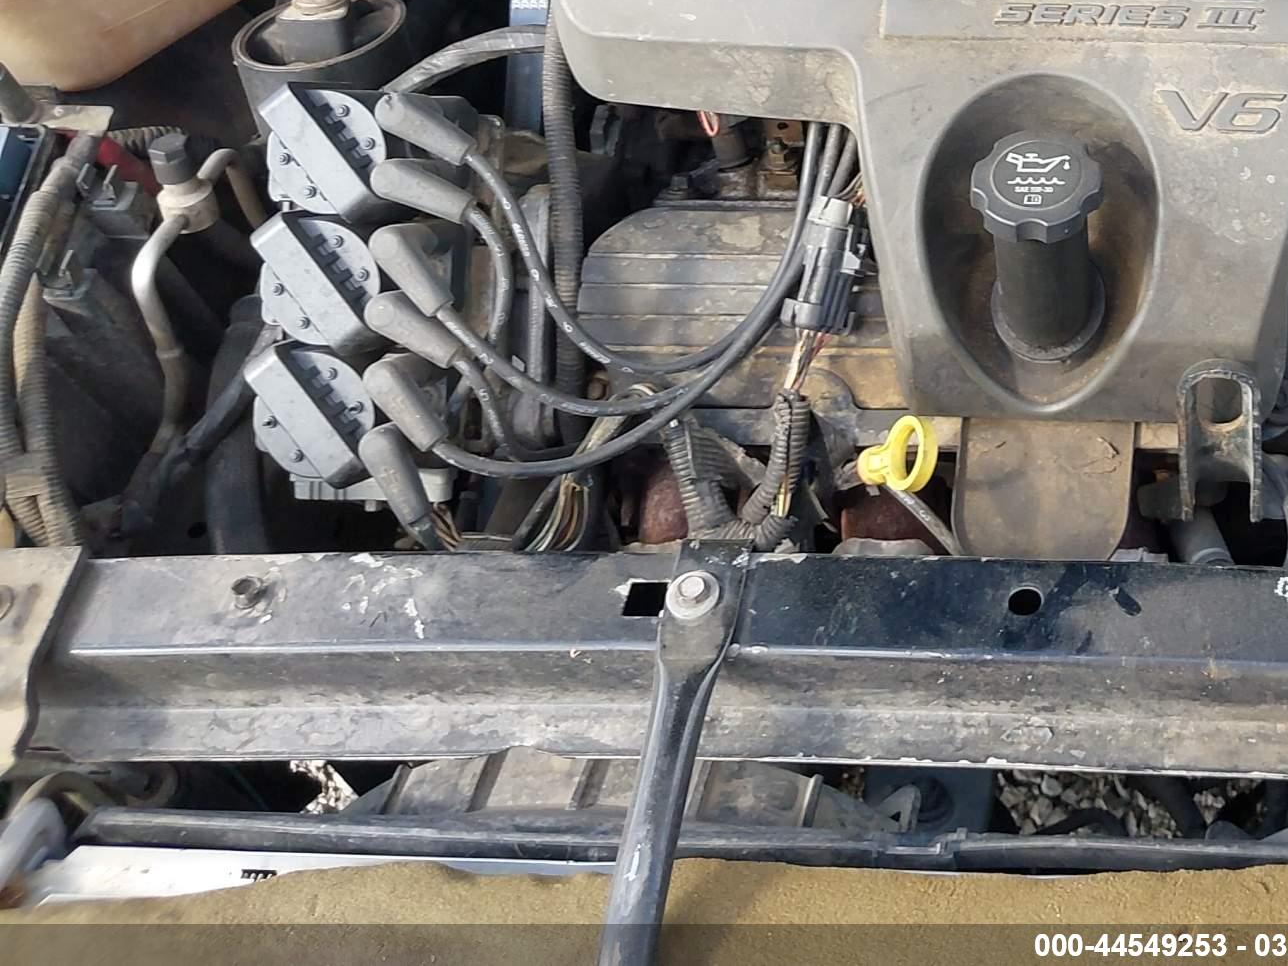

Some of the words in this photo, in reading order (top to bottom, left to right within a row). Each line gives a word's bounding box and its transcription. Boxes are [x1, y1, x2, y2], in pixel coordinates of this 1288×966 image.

[994, 3, 1192, 30] SERIES
[1197, 6, 1265, 31] III
[1155, 89, 1287, 134] V6
